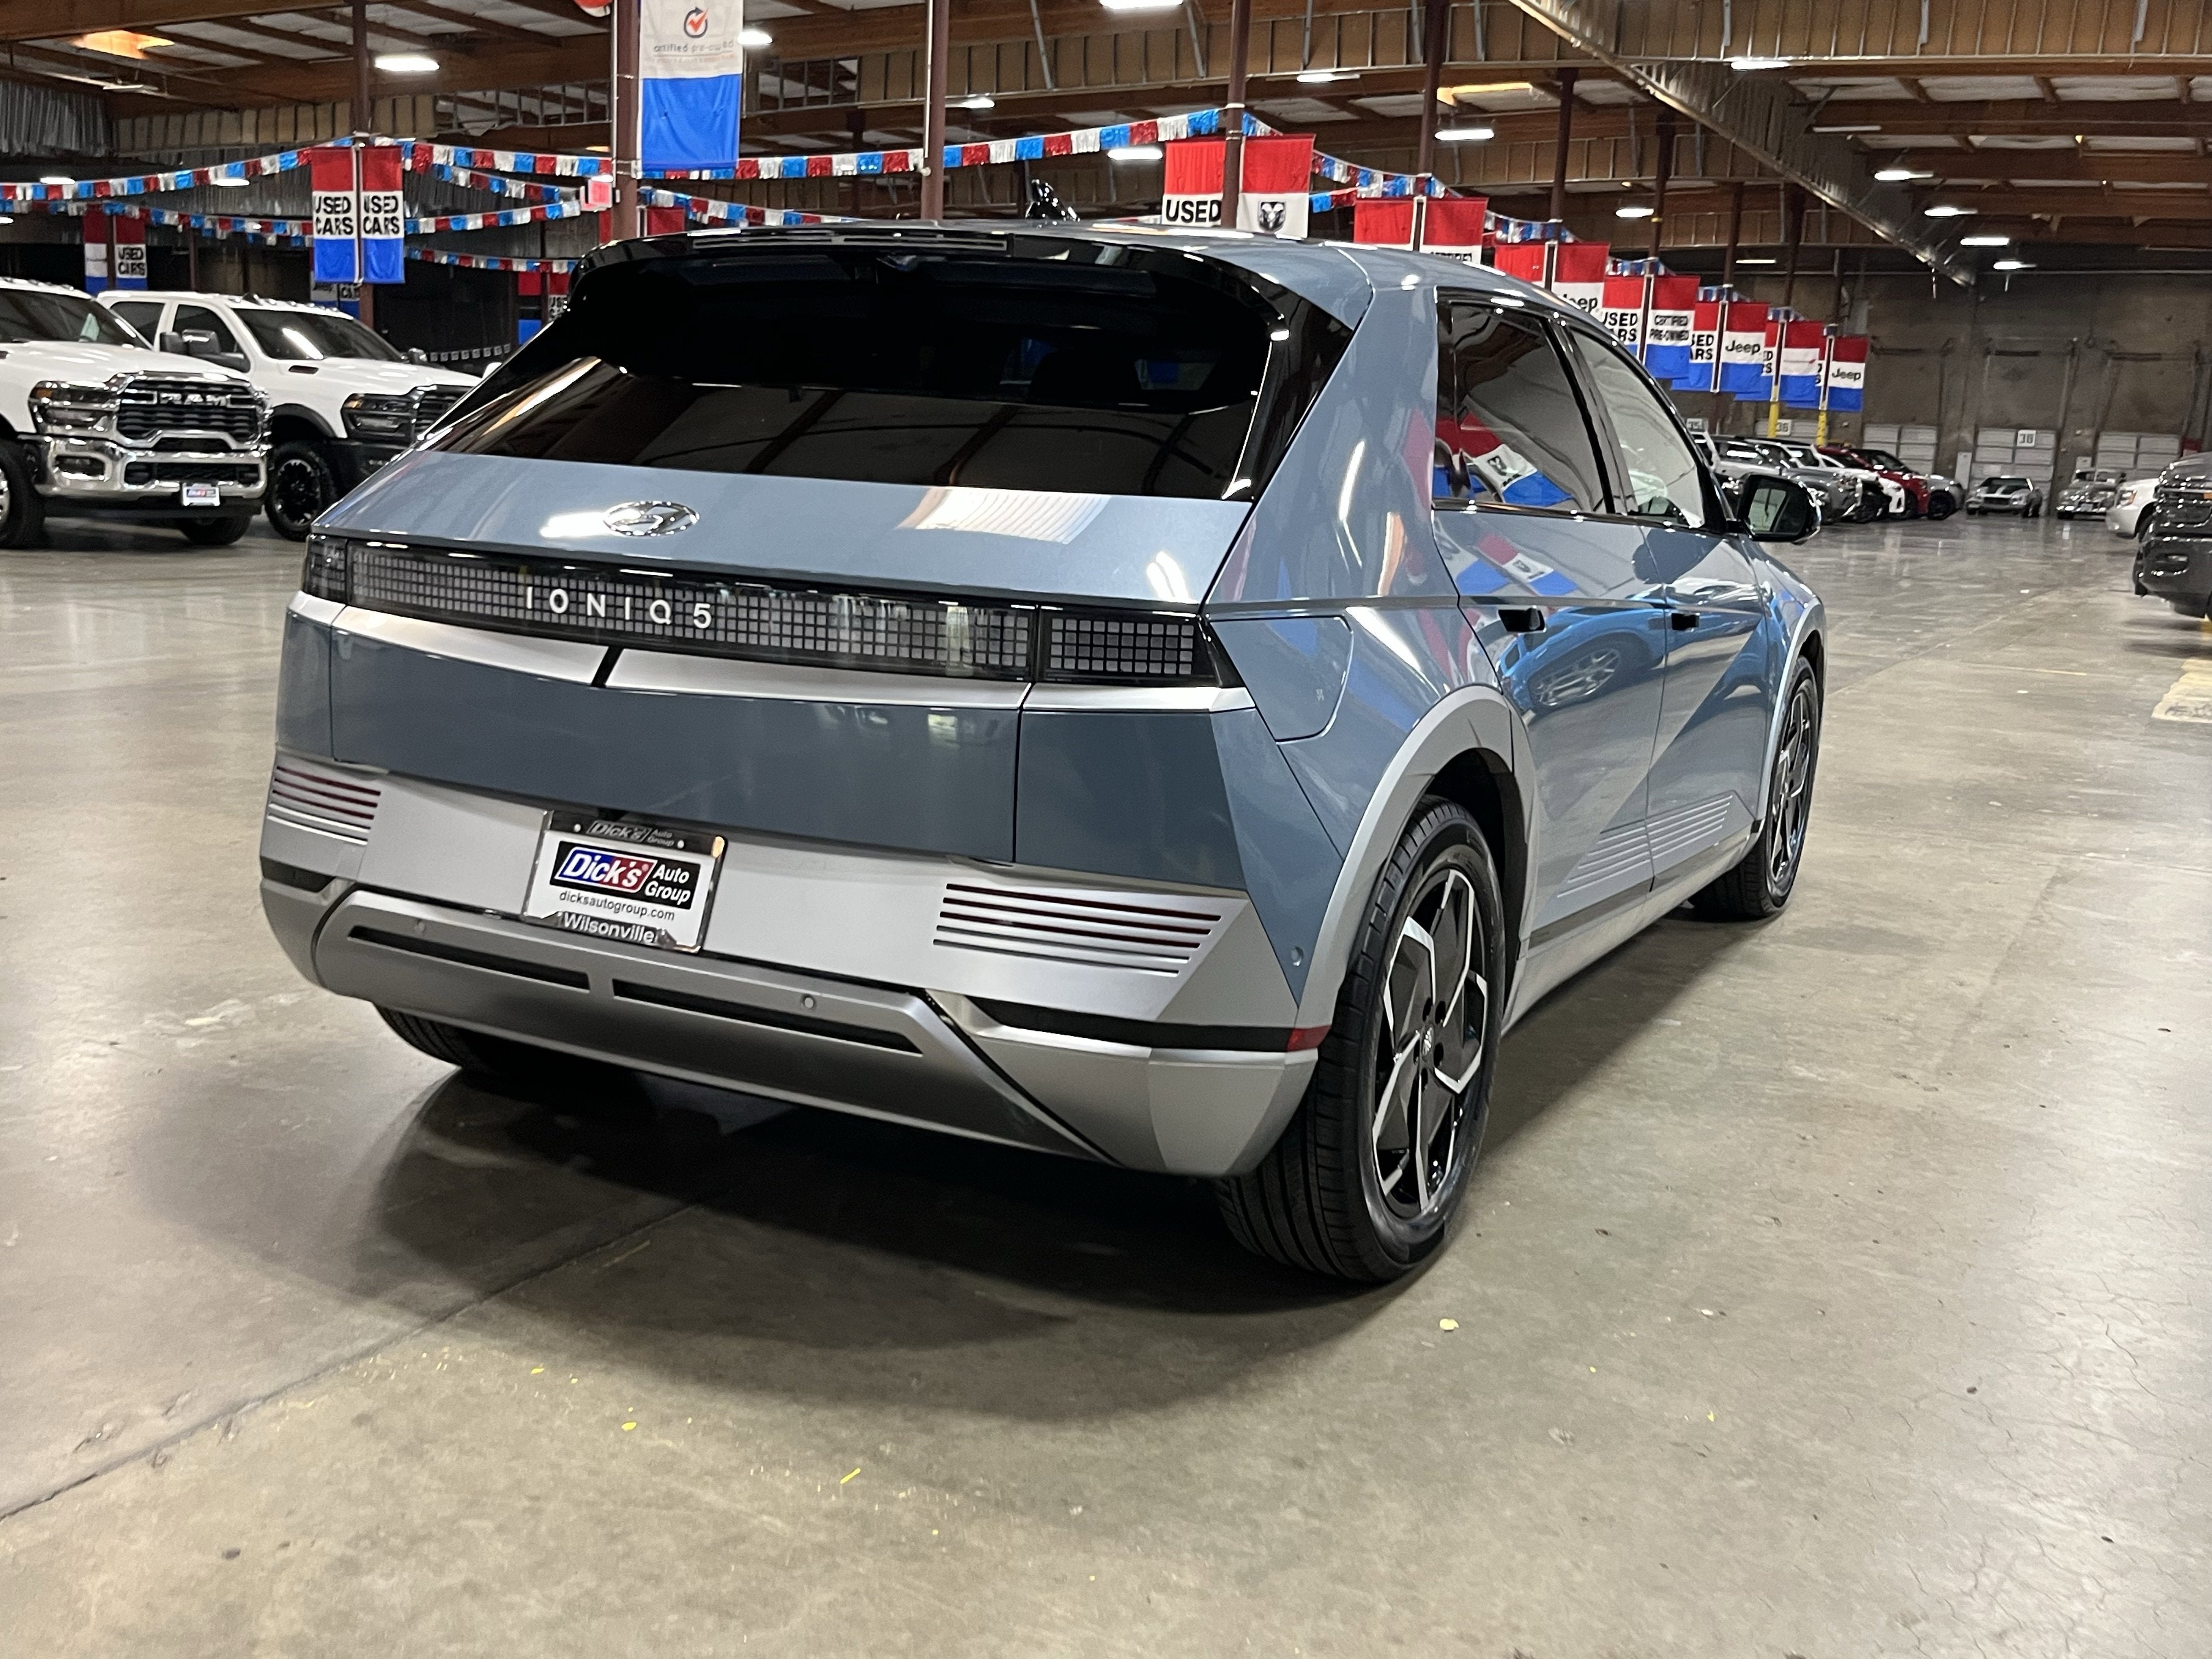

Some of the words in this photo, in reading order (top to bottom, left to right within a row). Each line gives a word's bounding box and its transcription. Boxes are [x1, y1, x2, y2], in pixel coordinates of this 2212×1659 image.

[314, 196, 351, 214] USED
[364, 195, 398, 214] USED
[1166, 200, 1222, 223] USED
[315, 217, 354, 235] CARS
[363, 216, 400, 235] CARS
[1725, 340, 1760, 355] Jeep
[1831, 368, 1861, 381] Jeep
[160, 393, 227, 406] RAM
[527, 586, 672, 624] IONIQ
[693, 603, 712, 629] 5
[647, 836, 675, 847] Group
[650, 828, 673, 839] Auto
[563, 854, 643, 888] Dick's
[652, 864, 690, 884] Auto
[645, 881, 691, 905] Group
[559, 890, 675, 921] dicksautogroup.com
[564, 912, 655, 944] Wilsonville
